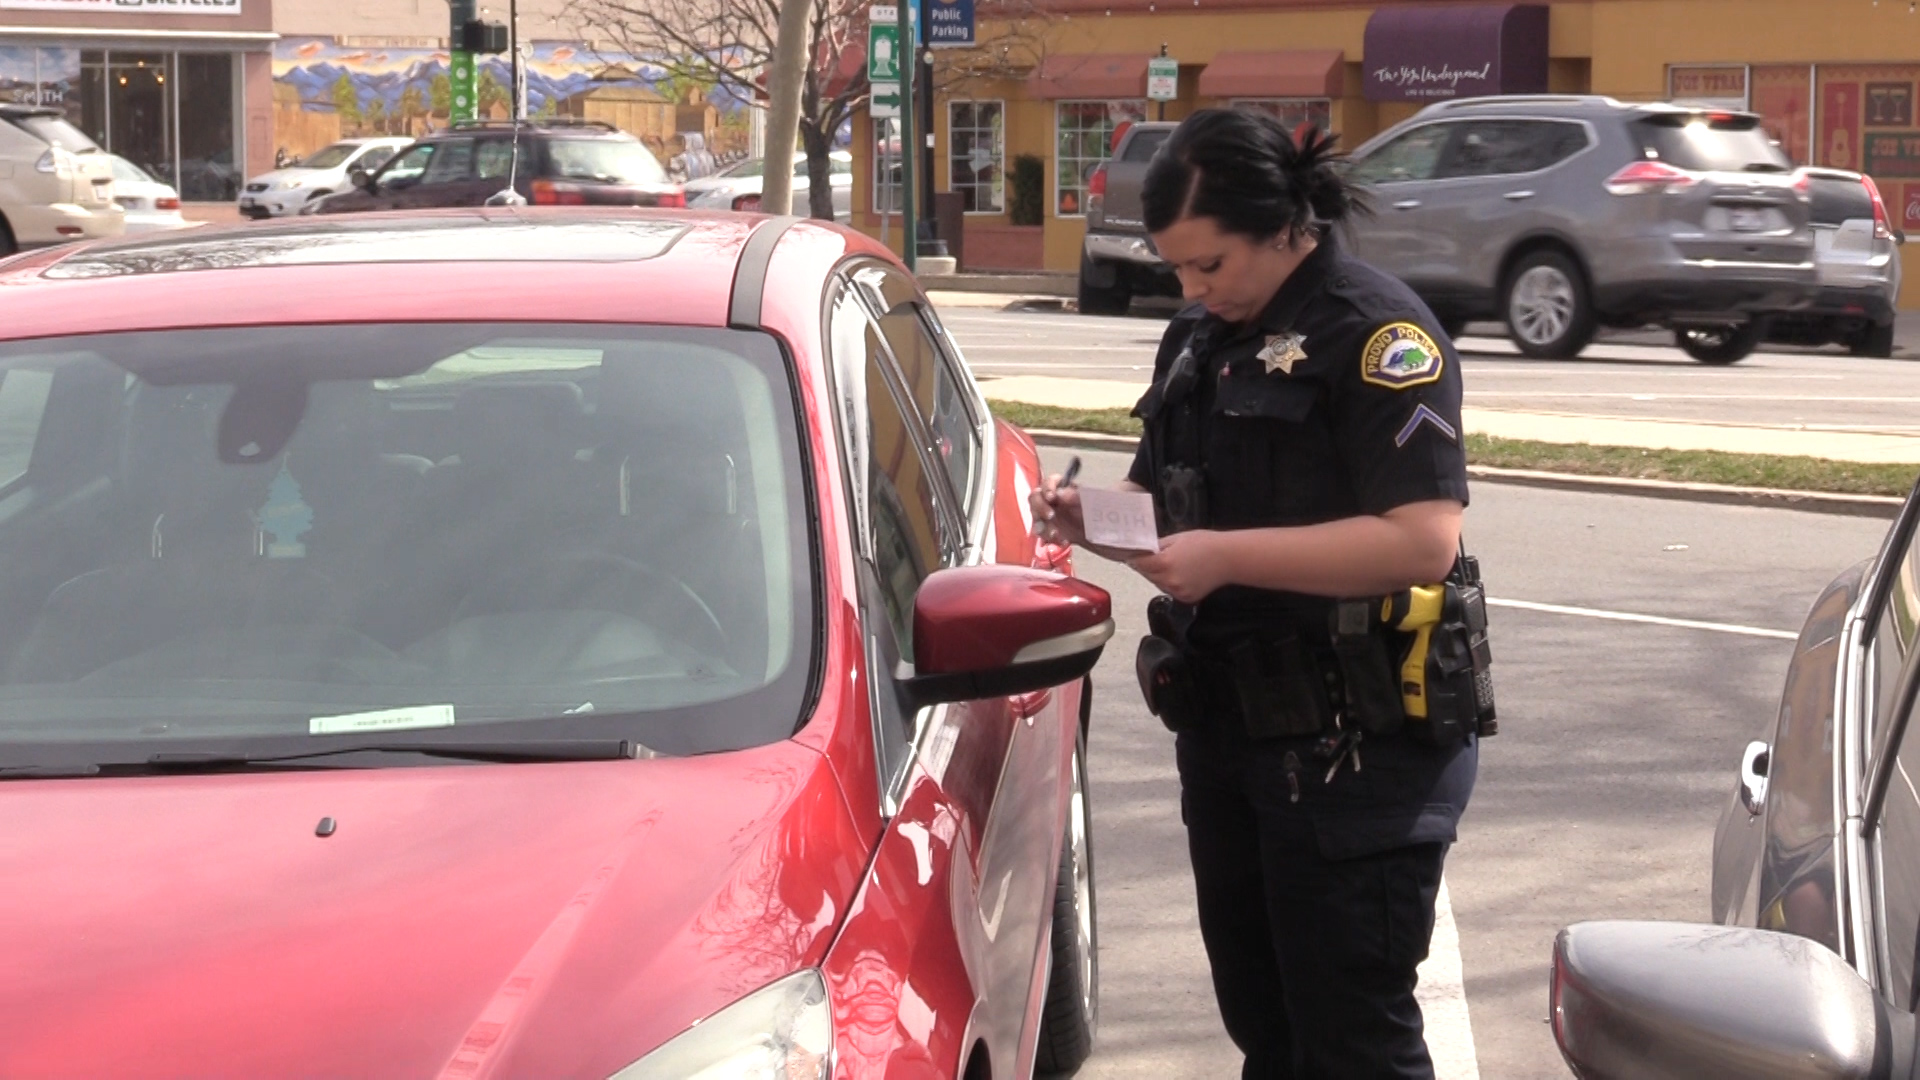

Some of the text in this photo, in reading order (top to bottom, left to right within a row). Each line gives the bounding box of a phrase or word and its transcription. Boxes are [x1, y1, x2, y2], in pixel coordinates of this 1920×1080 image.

[931, 9, 961, 20] Public
[932, 25, 968, 39] Parking
[1366, 333, 1393, 374] PROVO
